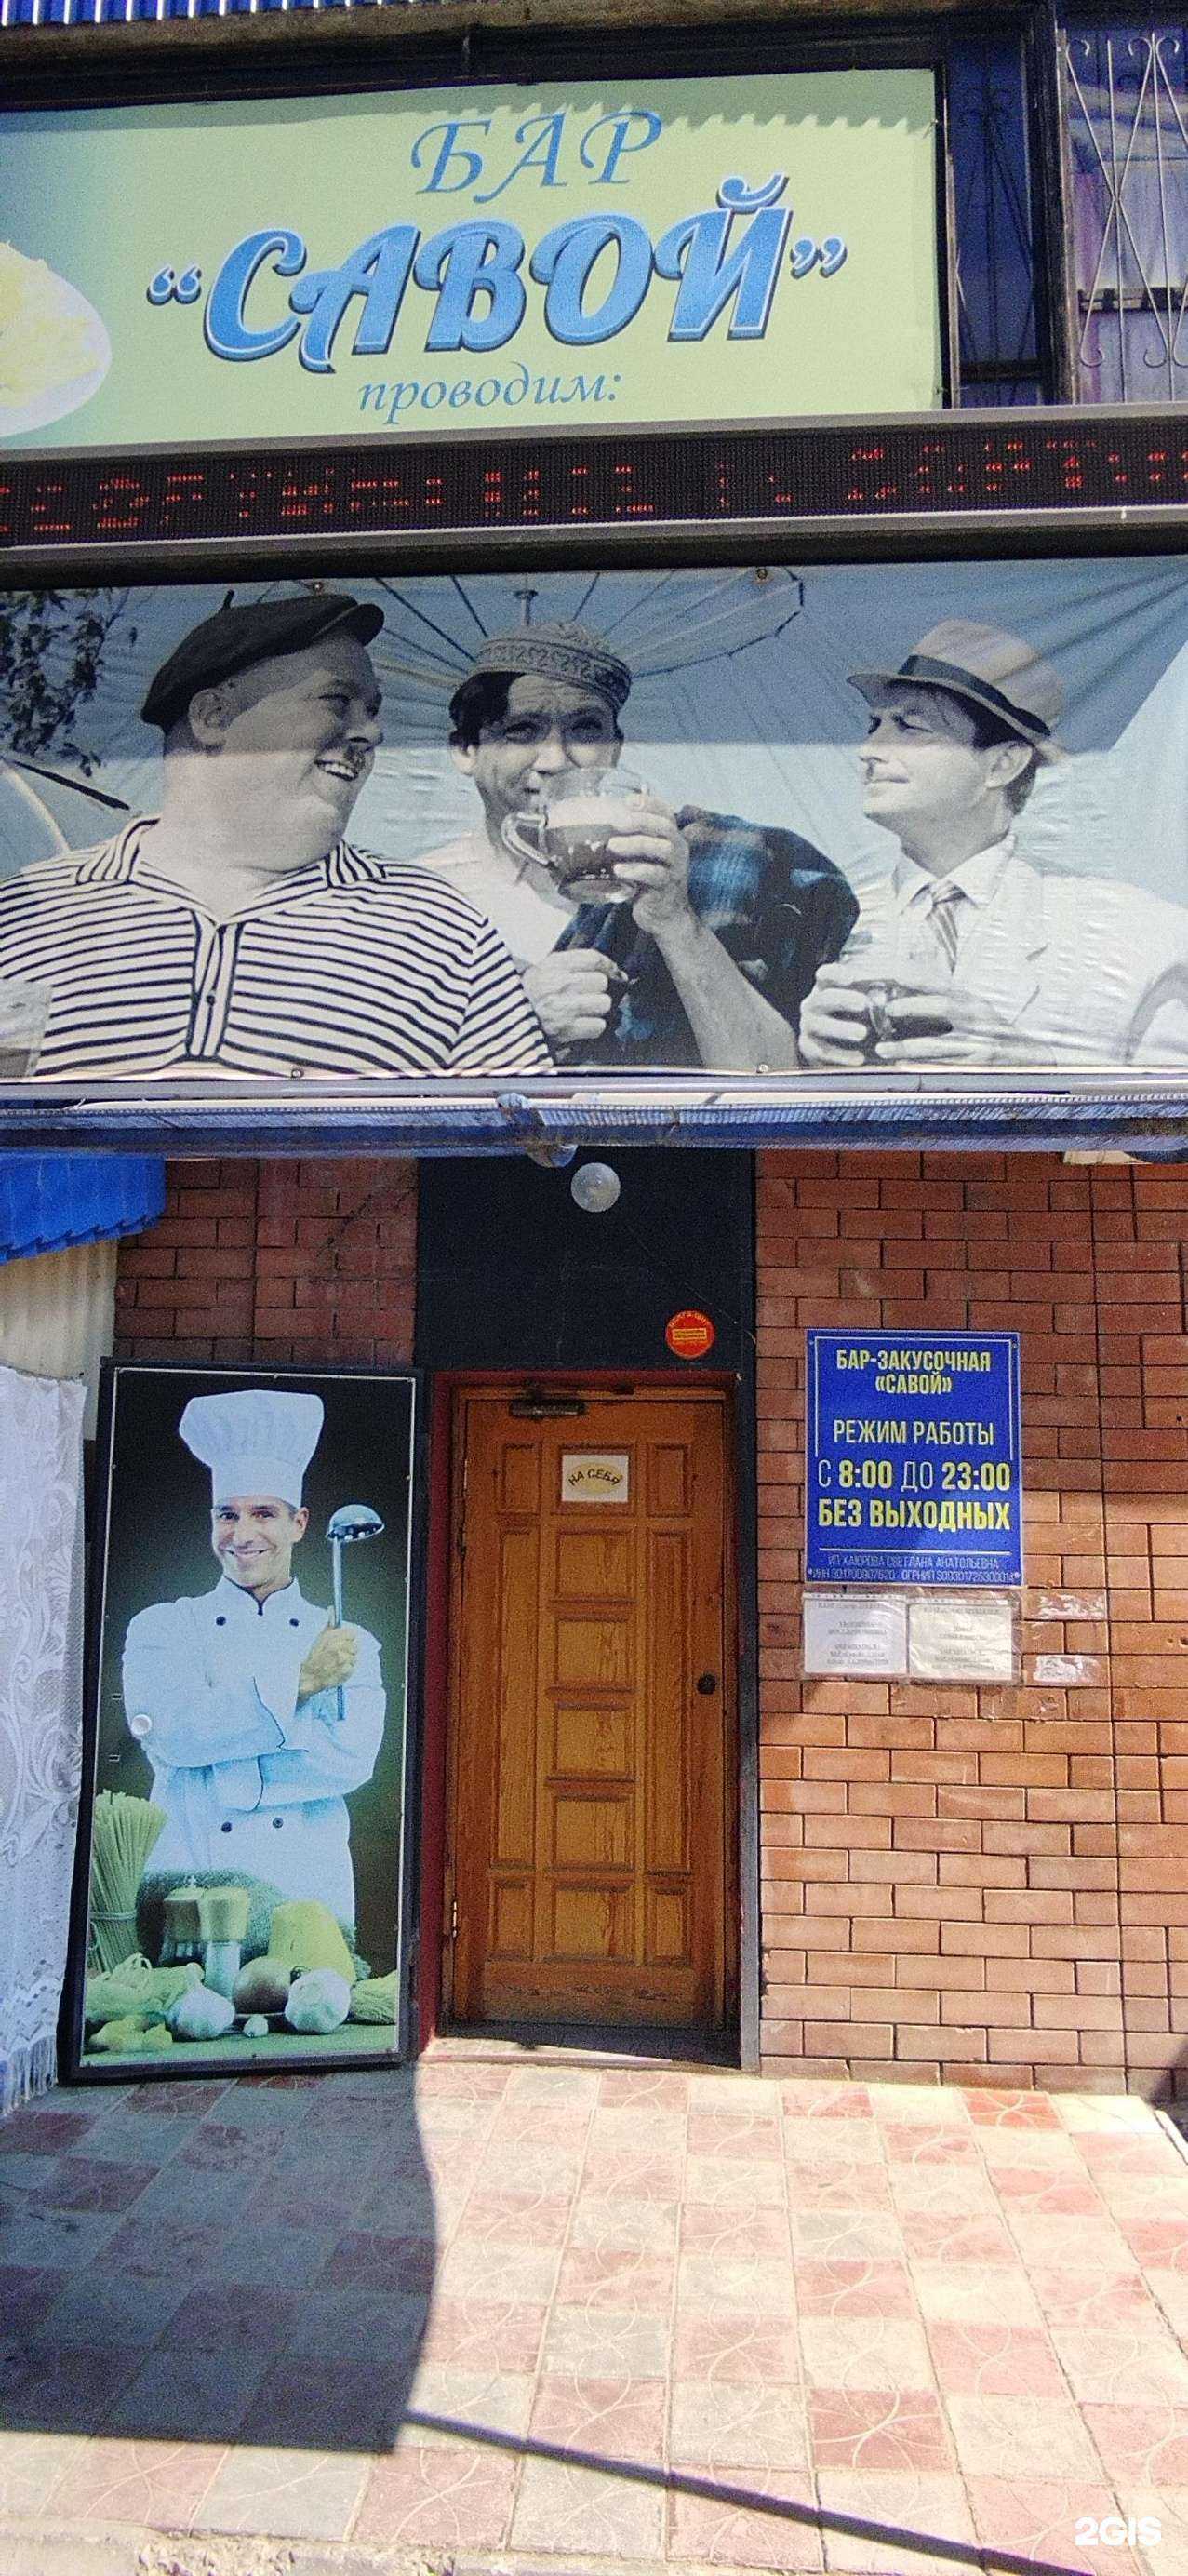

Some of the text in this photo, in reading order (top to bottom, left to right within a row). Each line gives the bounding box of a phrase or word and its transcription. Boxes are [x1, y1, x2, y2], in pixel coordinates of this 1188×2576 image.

[410, 110, 664, 203] БАР
[359, 360, 624, 425] проводим:
[835, 1349, 991, 1372] БАР-ЗАКУСОЧНАЯ
[875, 1371, 952, 1394] «САВОЙ»
[834, 1419, 994, 1446] РЕЖИМ РАБОТЫ
[567, 1468, 621, 1486] НА СЕБЯ
[818, 1458, 1010, 1492] С 8:00 ДО 23:00
[818, 1498, 1011, 1533] БЕЗ ВЫХОДНЫХ
[887, 1555, 934, 1568] СВЕТЛАНА
[935, 1556, 999, 1569] АНАТОЛЬЕВНА
